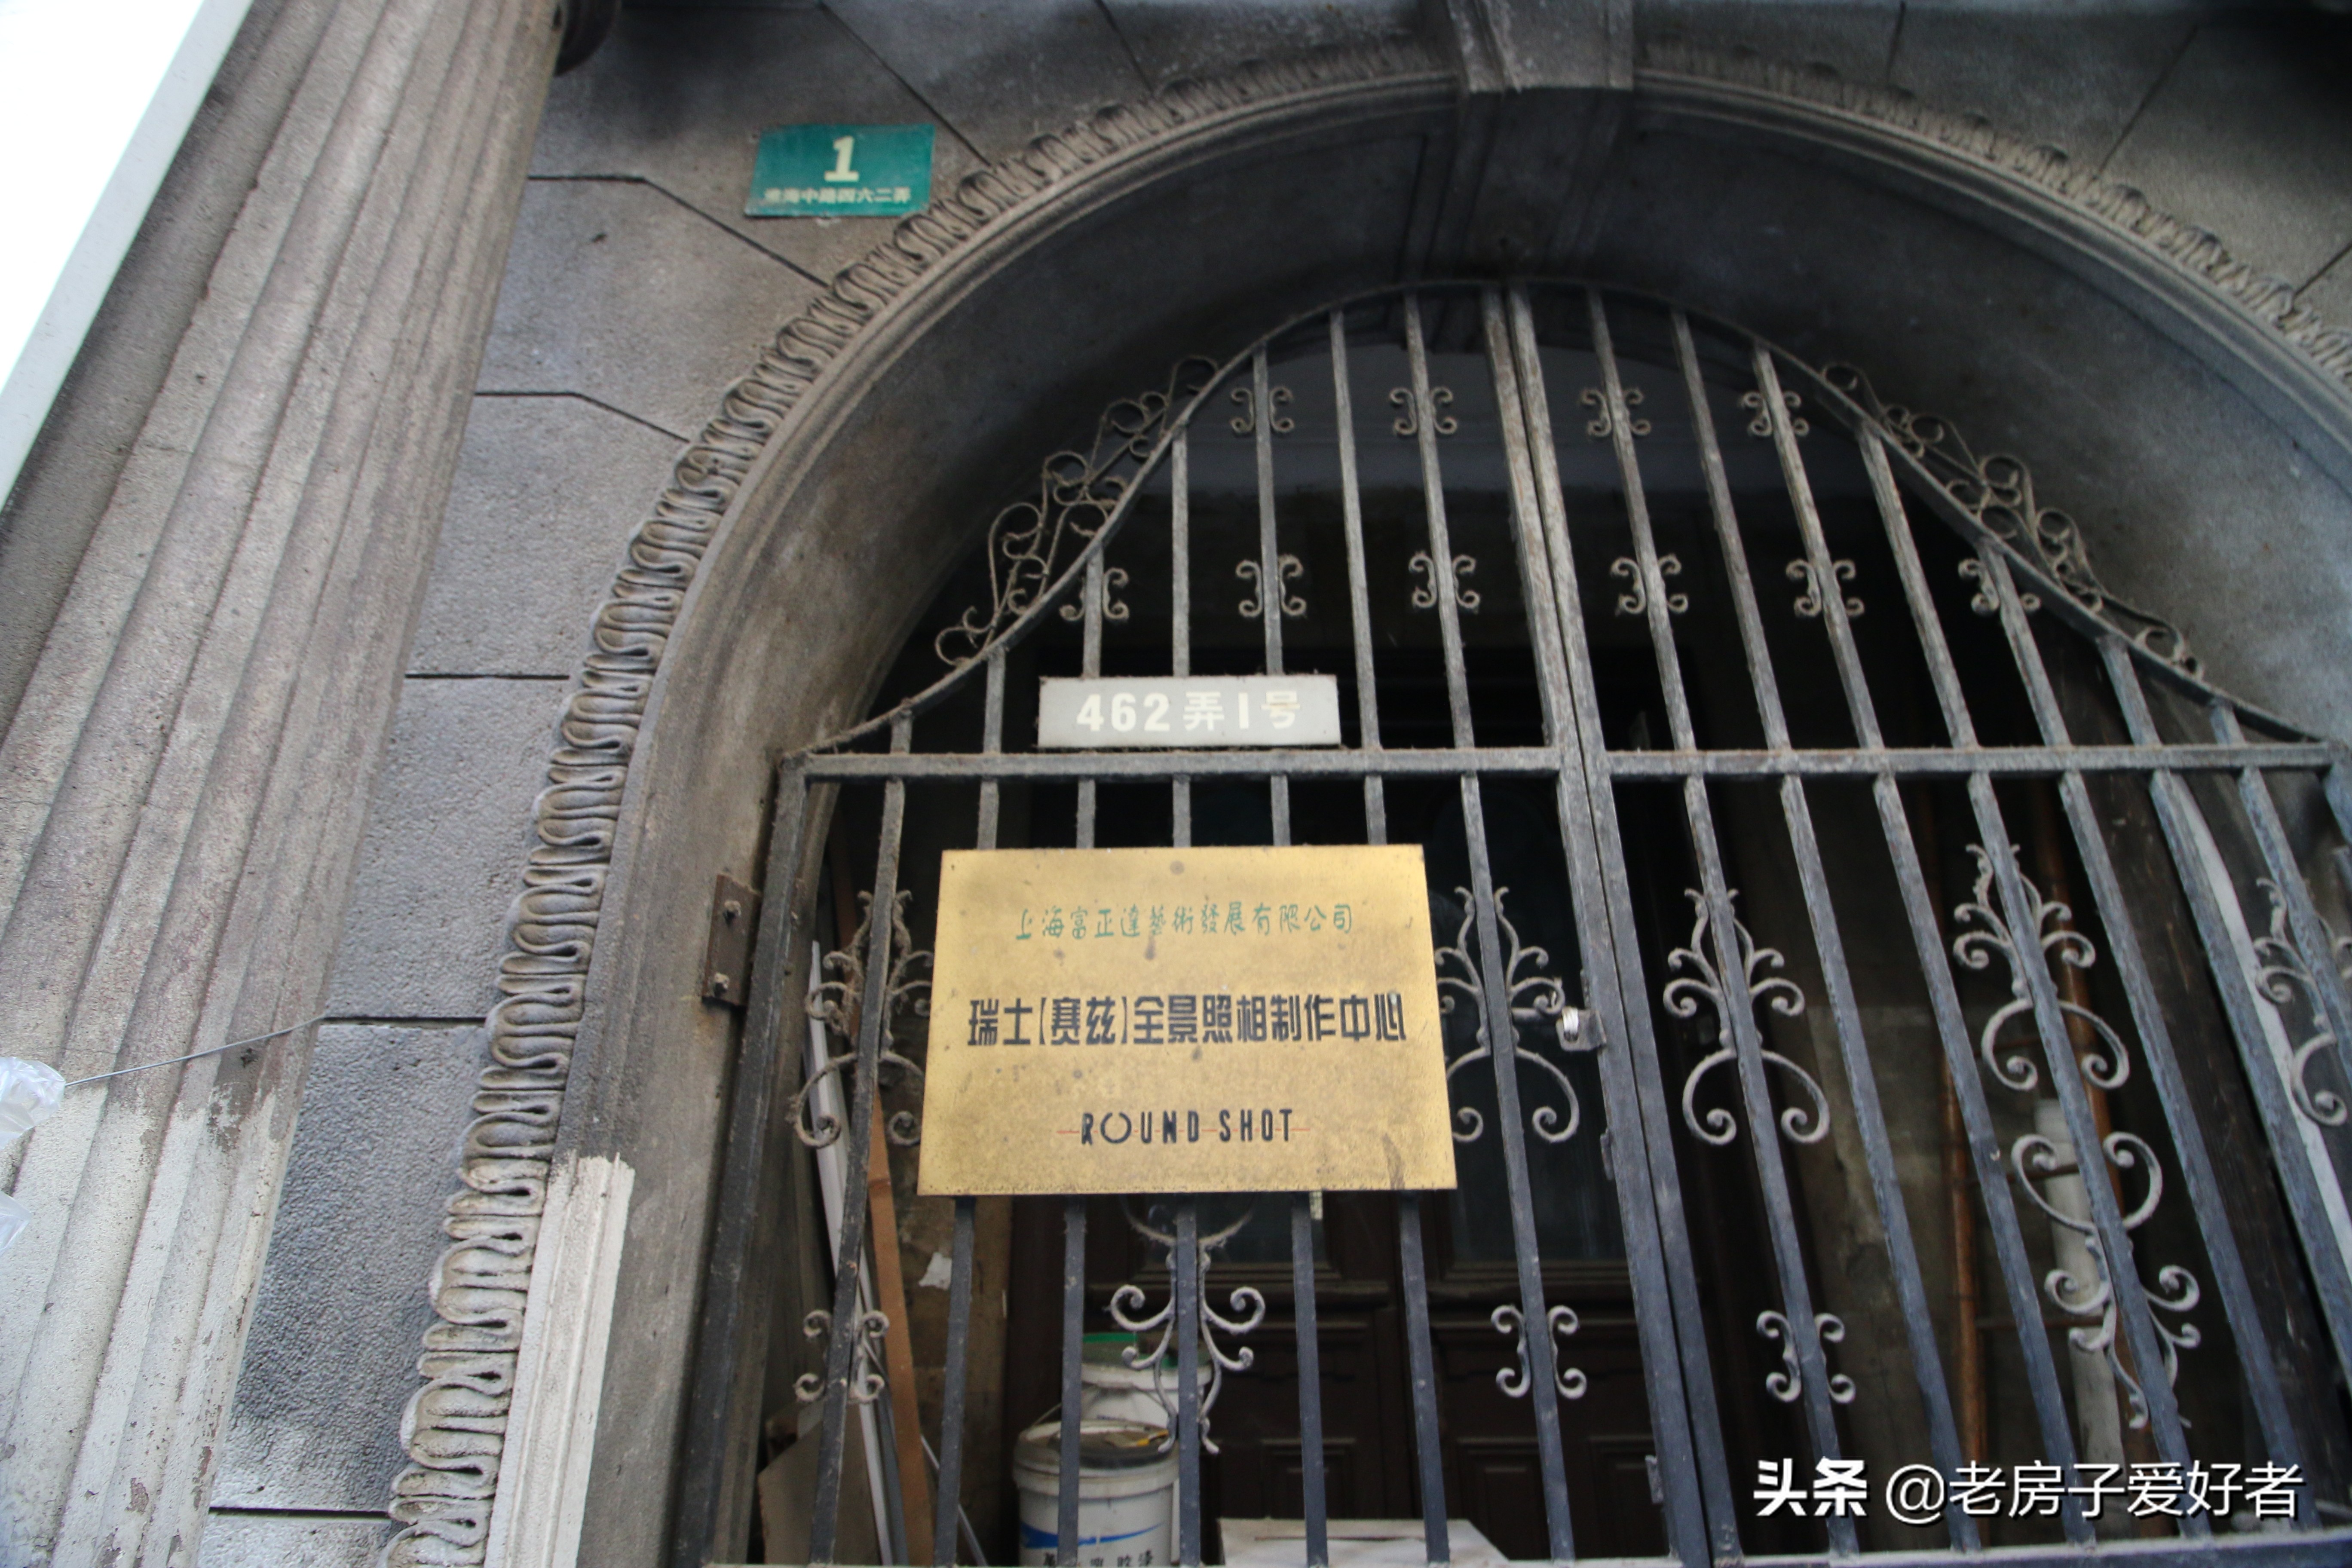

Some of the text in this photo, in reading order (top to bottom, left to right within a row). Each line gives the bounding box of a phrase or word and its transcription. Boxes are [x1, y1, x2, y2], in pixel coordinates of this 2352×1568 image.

[824, 135, 859, 182] 1
[1081, 1109, 1292, 1145] ROUND SHOT
